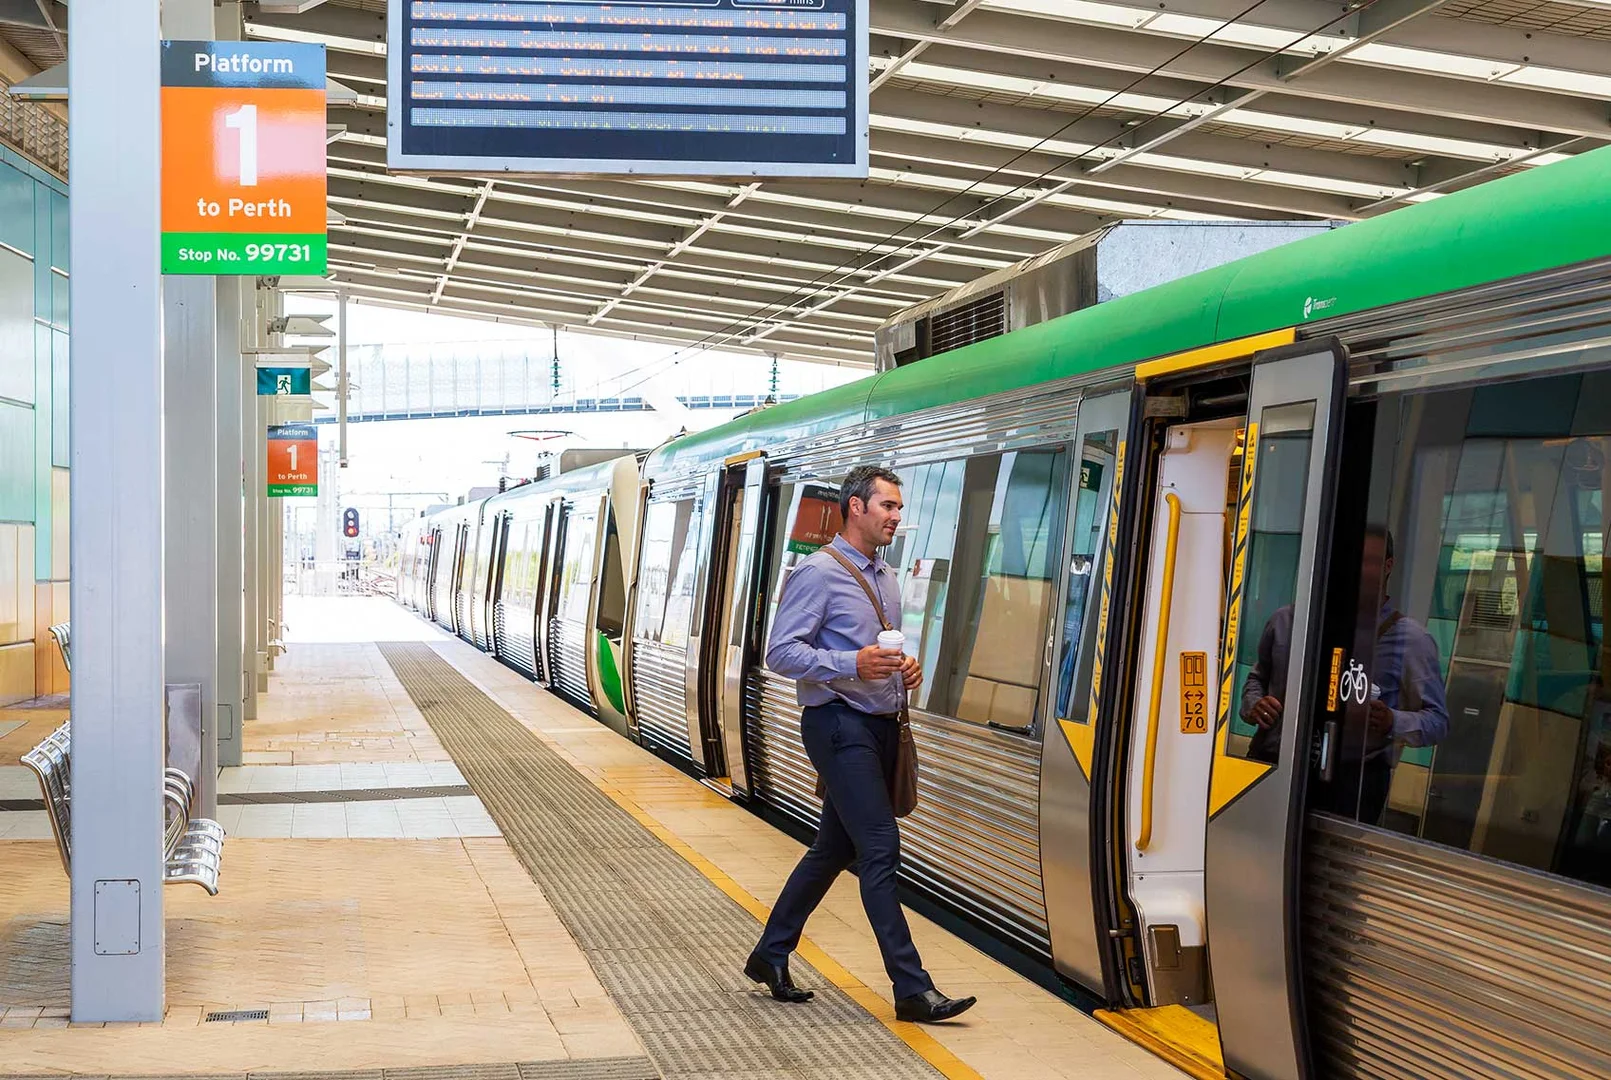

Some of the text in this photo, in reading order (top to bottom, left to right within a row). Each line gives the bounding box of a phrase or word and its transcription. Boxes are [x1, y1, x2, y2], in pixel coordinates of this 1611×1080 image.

[194, 52, 294, 74] Platform
[225, 104, 258, 186] 1
[197, 197, 292, 217] to Perth
[178, 244, 311, 263] Stop No. 99731
[277, 428, 309, 436] Platform
[286, 444, 297, 471] 1
[1185, 702, 1203, 715] L2
[1184, 716, 1205, 729] 70
